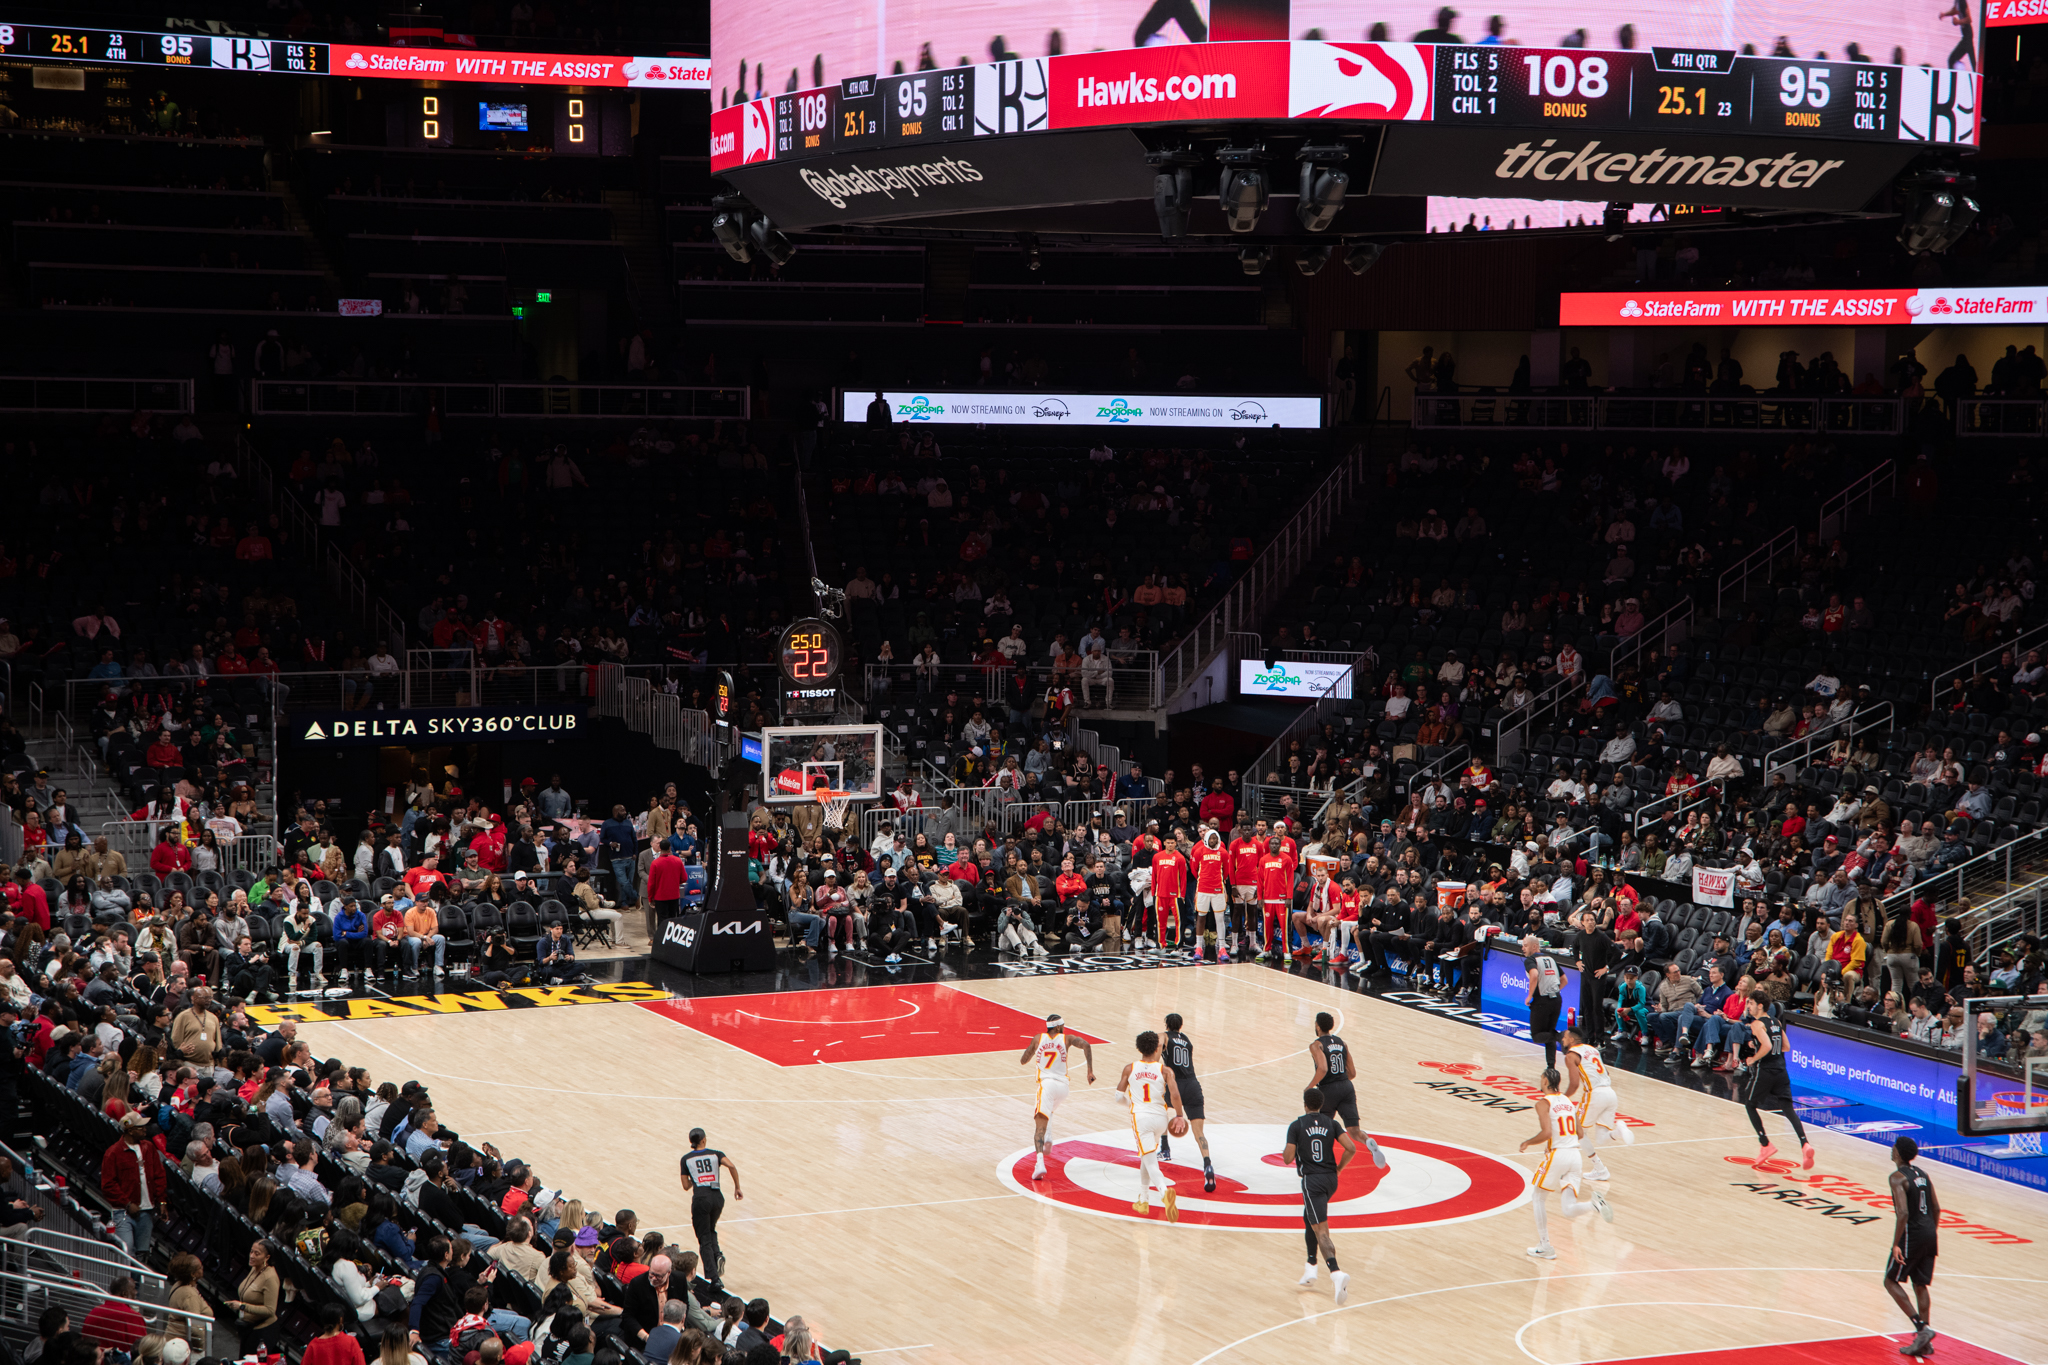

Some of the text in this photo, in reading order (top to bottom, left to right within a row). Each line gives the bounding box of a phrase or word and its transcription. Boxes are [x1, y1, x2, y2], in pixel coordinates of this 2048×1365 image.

[51, 34, 88, 54] 25.1
[109, 34, 123, 46] 23
[160, 35, 193, 56] 95
[106, 47, 126, 60] 4TH
[165, 55, 191, 65] BONUS
[287, 45, 316, 58] FLS 5
[1453, 51, 1498, 71] FLS 5
[1671, 53, 1718, 69] 4TH QTR
[287, 58, 316, 71] TOL 2
[455, 58, 506, 76] WITH
[511, 60, 546, 77] THE
[550, 62, 614, 79] ASSIST
[942, 73, 964, 91] FLS 5
[1453, 74, 1498, 93] TOL 2
[1523, 55, 1609, 98] 108
[1856, 70, 1887, 89] FLS 5
[849, 80, 869, 95] 4TH QTR
[1077, 71, 1237, 108] Hawks.com
[1779, 66, 1831, 109] 95
[779, 100, 792, 115] FLS 5
[898, 79, 927, 118] 95
[942, 94, 964, 112] TOL 2
[1452, 95, 1497, 115] CHL 1
[1658, 85, 1707, 116] 25.1
[1855, 91, 1887, 110] TOL 2
[798, 93, 827, 132] 108
[1543, 102, 1587, 118] BONUS
[1718, 102, 1732, 117] 23
[779, 118, 792, 133] TOL 2
[844, 110, 864, 137] 25.1
[869, 121, 876, 134] 23
[902, 121, 922, 136] BONUS
[942, 114, 964, 131] CHL 1
[1785, 111, 1821, 128] BONUS
[1854, 112, 1885, 131] CHL 1
[711, 131, 735, 157] ks.com
[779, 136, 792, 152] CHL 1
[805, 135, 820, 148] BONUS
[1495, 138, 1844, 189] ticketmaster
[1731, 300, 1785, 317] WITH
[1789, 299, 1828, 316] THE
[1830, 297, 1898, 315] ASSIST
[951, 405, 1026, 417] NOW STREAMING ON
[1149, 407, 1223, 418] NOW STREAMING ON
[791, 633, 822, 650] 25.0
[794, 649, 828, 678] 22
[1252, 673, 1302, 686] ZOOTOPIA
[800, 688, 836, 698] TISSOT
[334, 719, 418, 738] DELTA
[1310, 864, 1317, 875] G
[1698, 872, 1728, 889] HAWKS
[1438, 893, 1446, 905] G
[662, 921, 695, 948] paze
[712, 921, 761, 935] KIA
[245, 981, 674, 1025] HAWKS
[1381, 991, 1531, 1031] CHASE
[1771, 1035, 1781, 1055] 77
[1044, 1051, 1058, 1069] 7
[1173, 1045, 1189, 1068] 00
[1330, 1053, 1345, 1074] 31
[1592, 1057, 1604, 1074] 3
[1134, 1072, 1158, 1081] JOHNSON
[1792, 1049, 1958, 1106] Big-league performance for Atla
[1143, 1083, 1151, 1103] 1
[1414, 1081, 1533, 1114] ARENA
[1305, 1126, 1328, 1137] LIDDELL
[1558, 1115, 1577, 1136] 10
[1311, 1139, 1323, 1162] 9
[695, 1158, 713, 1174] 98
[1730, 1183, 1882, 1226] ARENA
[1919, 1190, 1927, 1215] 4
